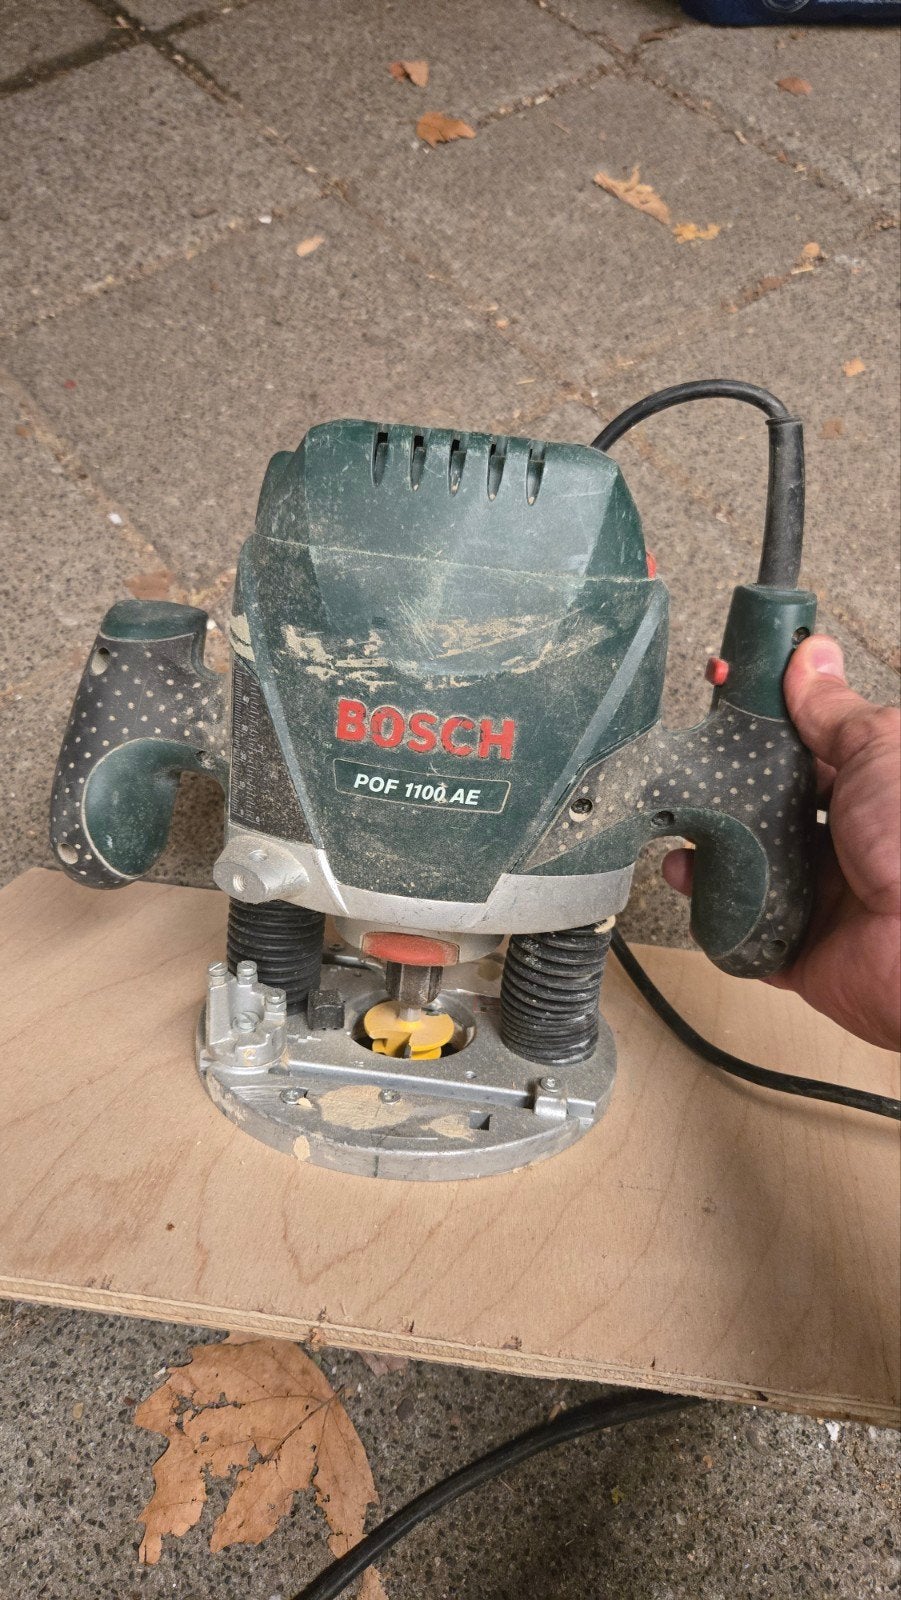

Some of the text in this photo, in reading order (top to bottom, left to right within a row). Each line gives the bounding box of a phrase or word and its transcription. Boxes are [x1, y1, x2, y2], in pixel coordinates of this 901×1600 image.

[336, 698, 516, 760] BOSCH
[353, 773, 481, 806] POF 1100 AE
